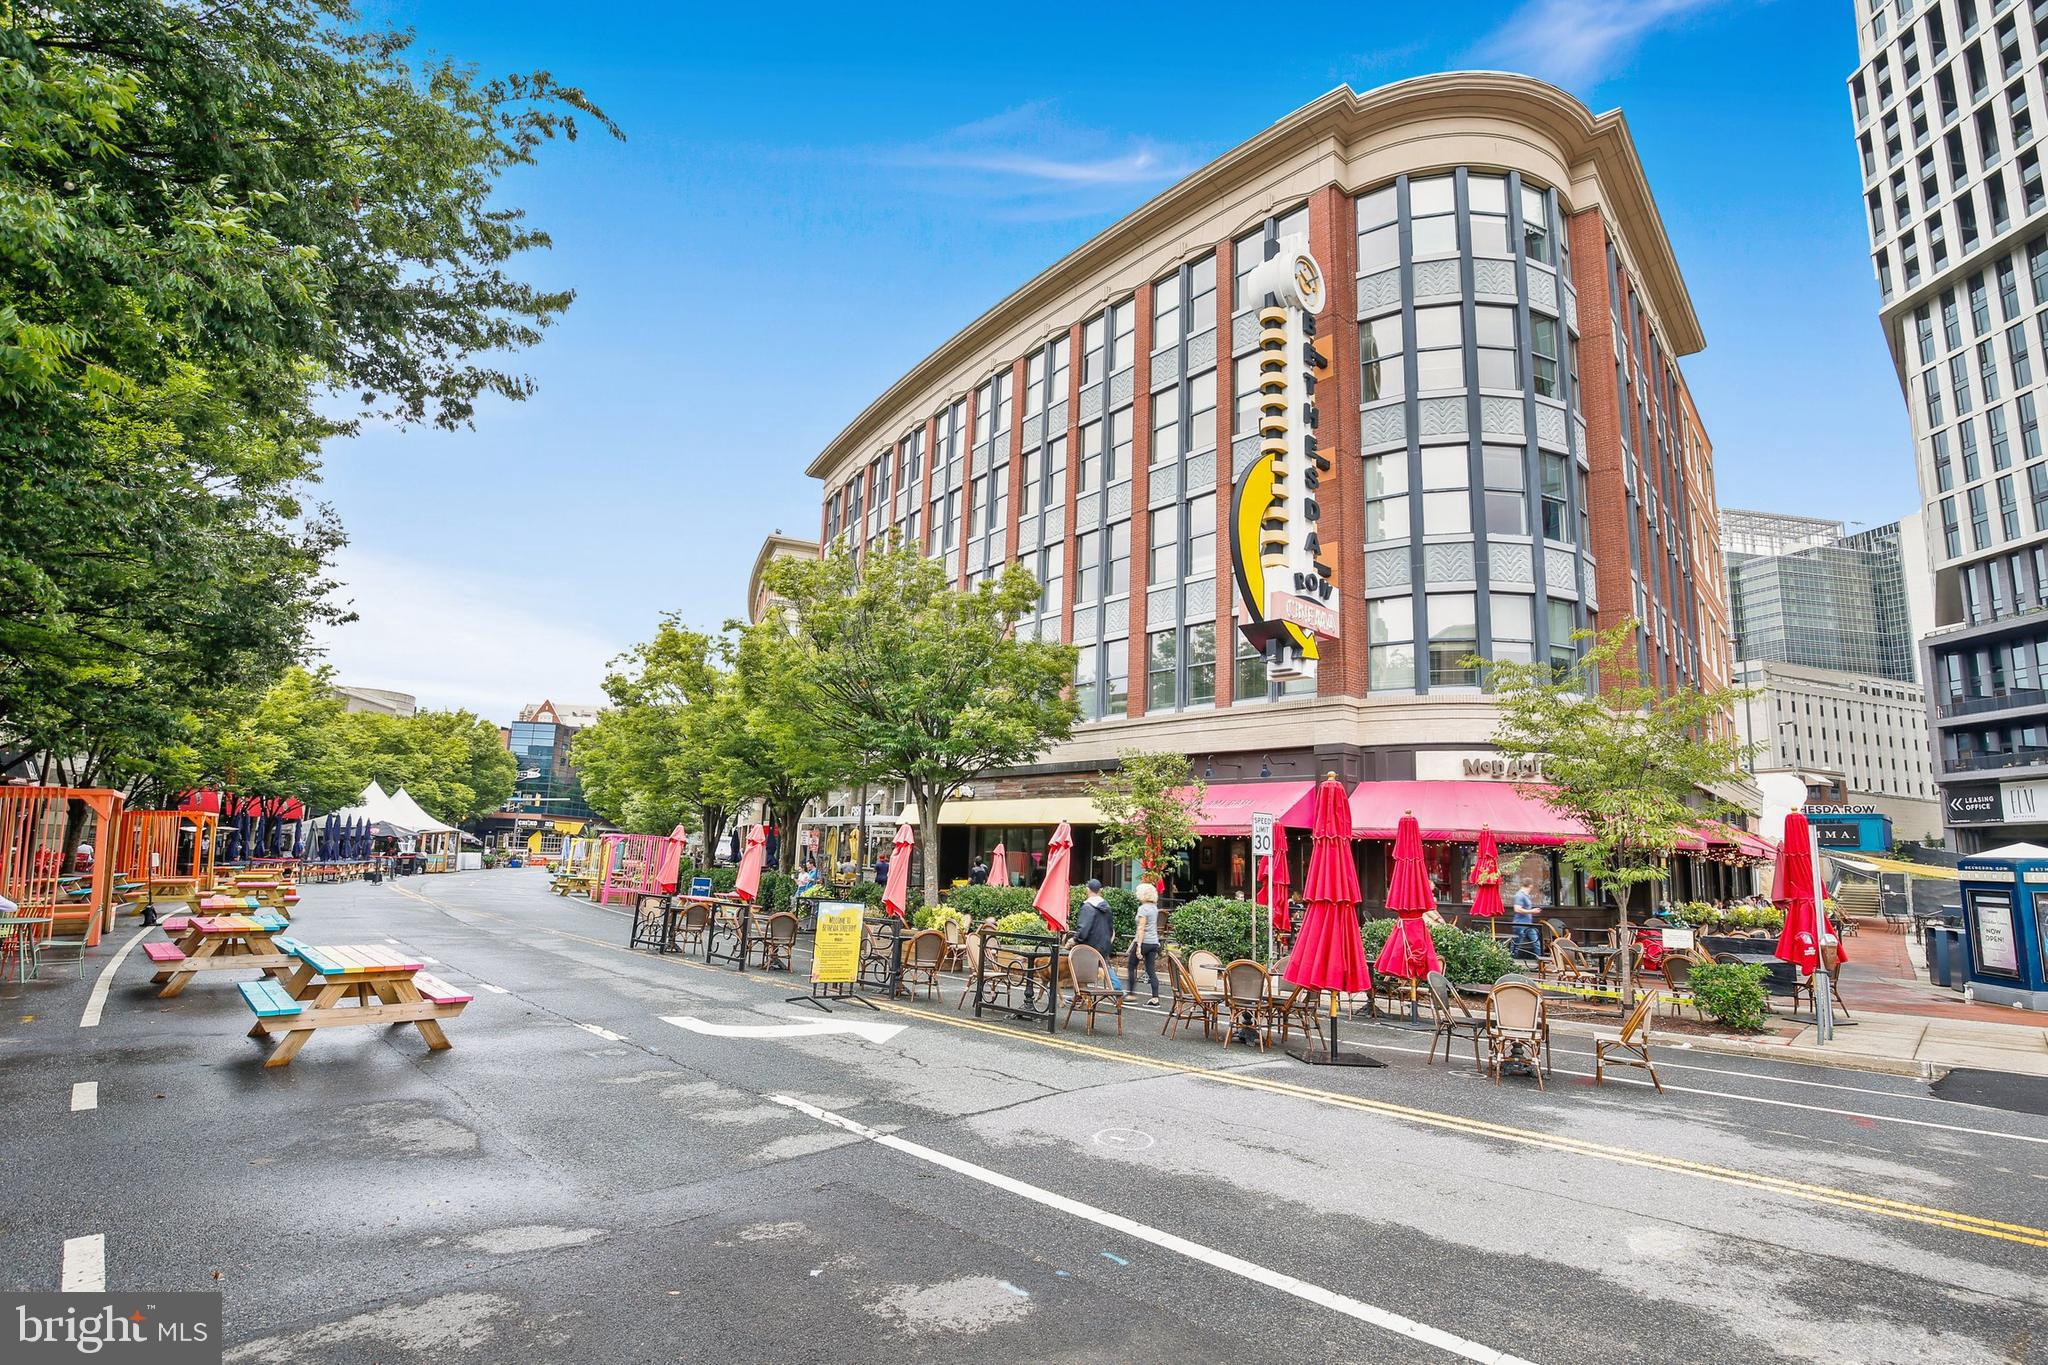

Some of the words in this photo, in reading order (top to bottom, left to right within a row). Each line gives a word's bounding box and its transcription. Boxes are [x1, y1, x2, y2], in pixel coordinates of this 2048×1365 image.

[1302, 311, 1321, 556] BETHESDA
[1293, 572, 1333, 600] ROW
[1965, 795, 1995, 804] LEASING
[1843, 805, 1876, 814] ROW
[1965, 803, 1991, 811] OFFICE
[1253, 817, 1272, 825] SPEED
[1254, 835, 1271, 850] 30
